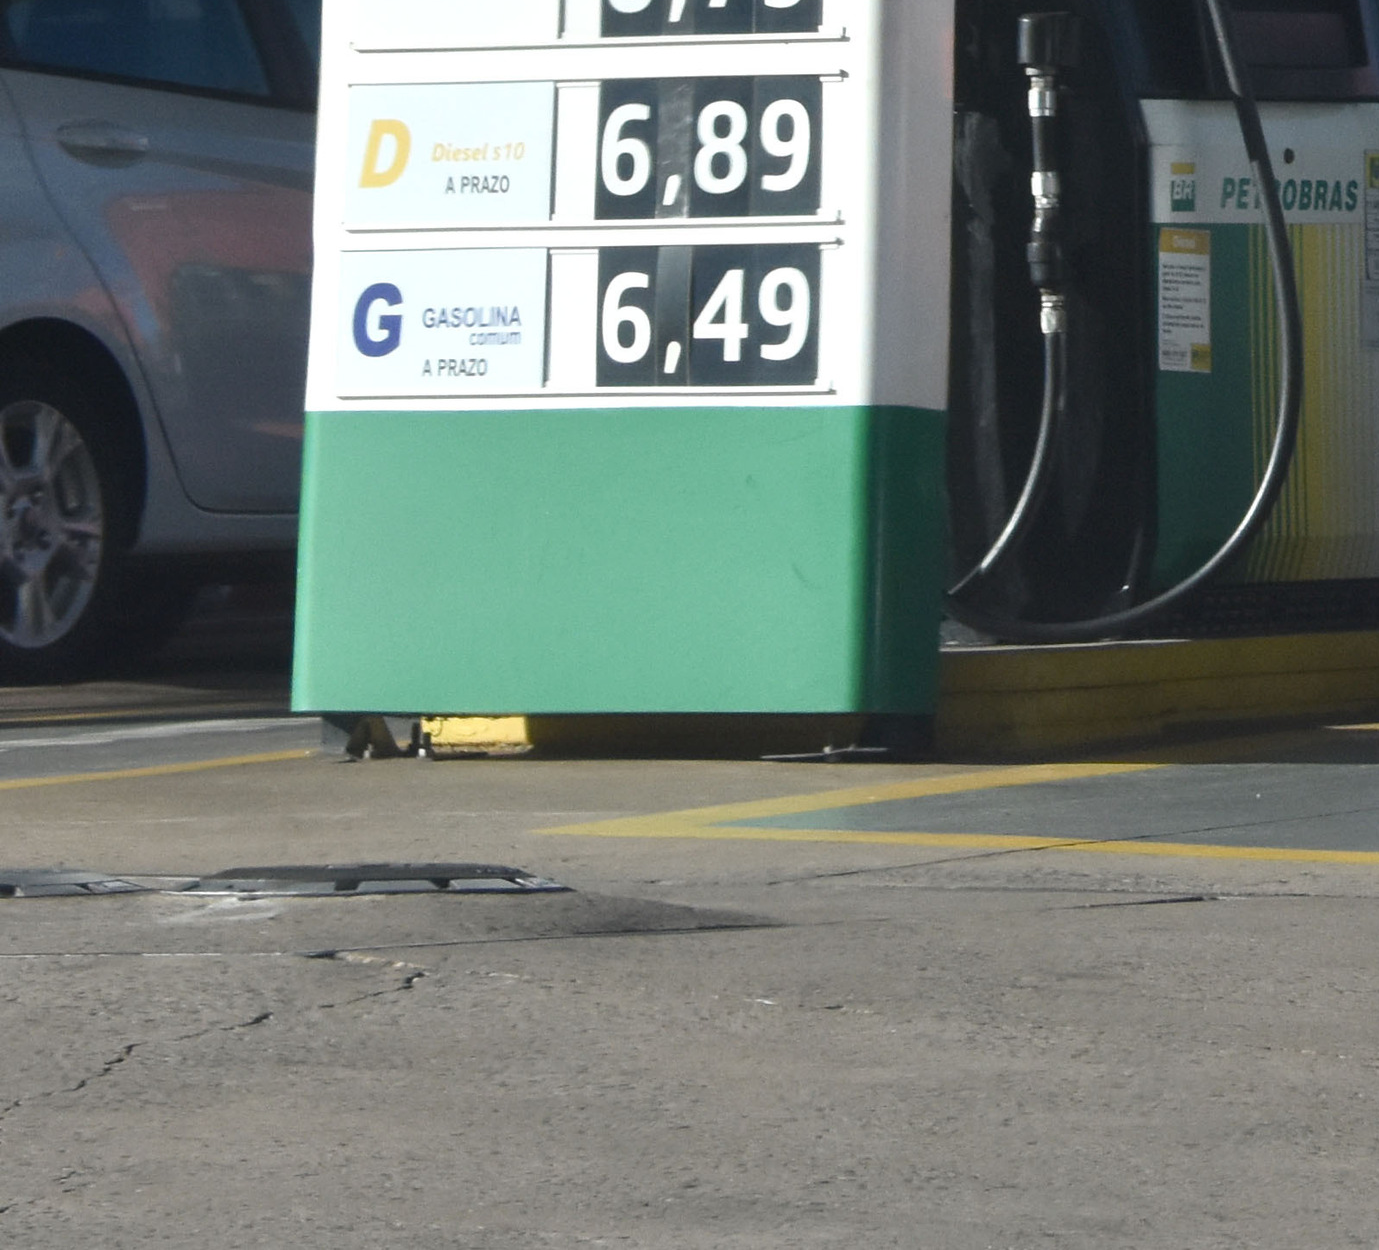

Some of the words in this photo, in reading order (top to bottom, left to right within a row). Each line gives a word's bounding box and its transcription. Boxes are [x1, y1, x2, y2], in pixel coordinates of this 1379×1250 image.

[358, 118, 412, 189] D
[431, 142, 489, 163] Diesel
[600, 98, 812, 206] 6,89
[445, 177, 455, 194] A
[460, 174, 510, 195] PRAZO
[1220, 176, 1359, 213] PEOBRAS
[352, 282, 405, 358] G
[422, 305, 522, 330] GASOLINA
[601, 265, 812, 375] 6,49
[469, 331, 522, 346] comum
[422, 359, 433, 376] A
[437, 358, 488, 378] PRAZO
